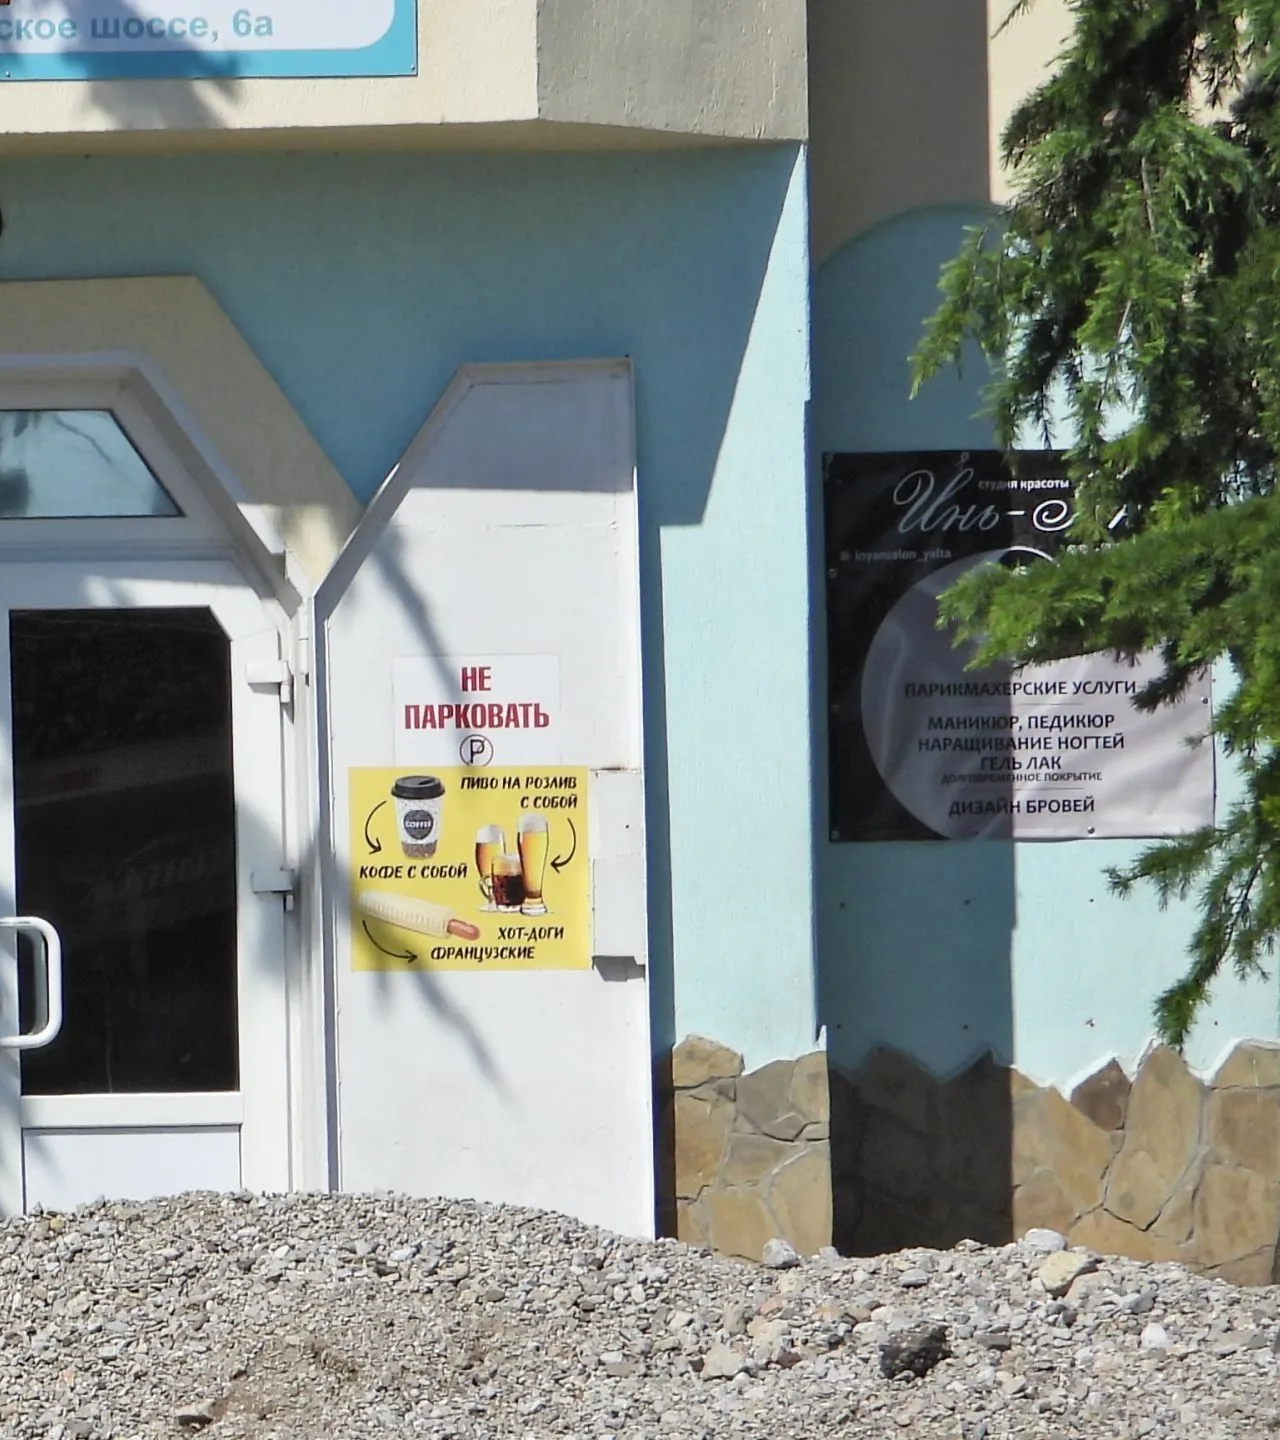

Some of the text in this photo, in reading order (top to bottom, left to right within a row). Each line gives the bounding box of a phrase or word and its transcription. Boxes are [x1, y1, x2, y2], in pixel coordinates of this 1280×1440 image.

[91, 16, 218, 43] шоссе,
[233, 9, 273, 38] 6а
[1020, 479, 1069, 492] красоты
[461, 667, 491, 692] НЕ
[904, 681, 1136, 698] ПАРИКМАХЕРСКИЕ УСЛУГИ
[404, 703, 550, 729] ПАРКОВАТЬ
[928, 714, 1115, 732] МАНИКЮР, ПЕДИКЮР
[918, 733, 1125, 755] НАРАЩИВАНИЕ НОГТЕЙ
[980, 756, 1061, 771] ГЕЛЬ ЛАК
[460, 776, 577, 790] ПИВО НА РОЗЛИВ
[1044, 772, 1102, 782] ПОКРЫТИЕ
[520, 793, 577, 809] С СОБОЙ
[949, 797, 1095, 817] ДИЗАЙН БРОВЕЙ
[359, 863, 468, 879] КОФЕ С СОБОЙ
[498, 926, 564, 941] ХОТ-ДОГИ
[430, 946, 535, 963] ФРАНЦУЗСКИЕ
